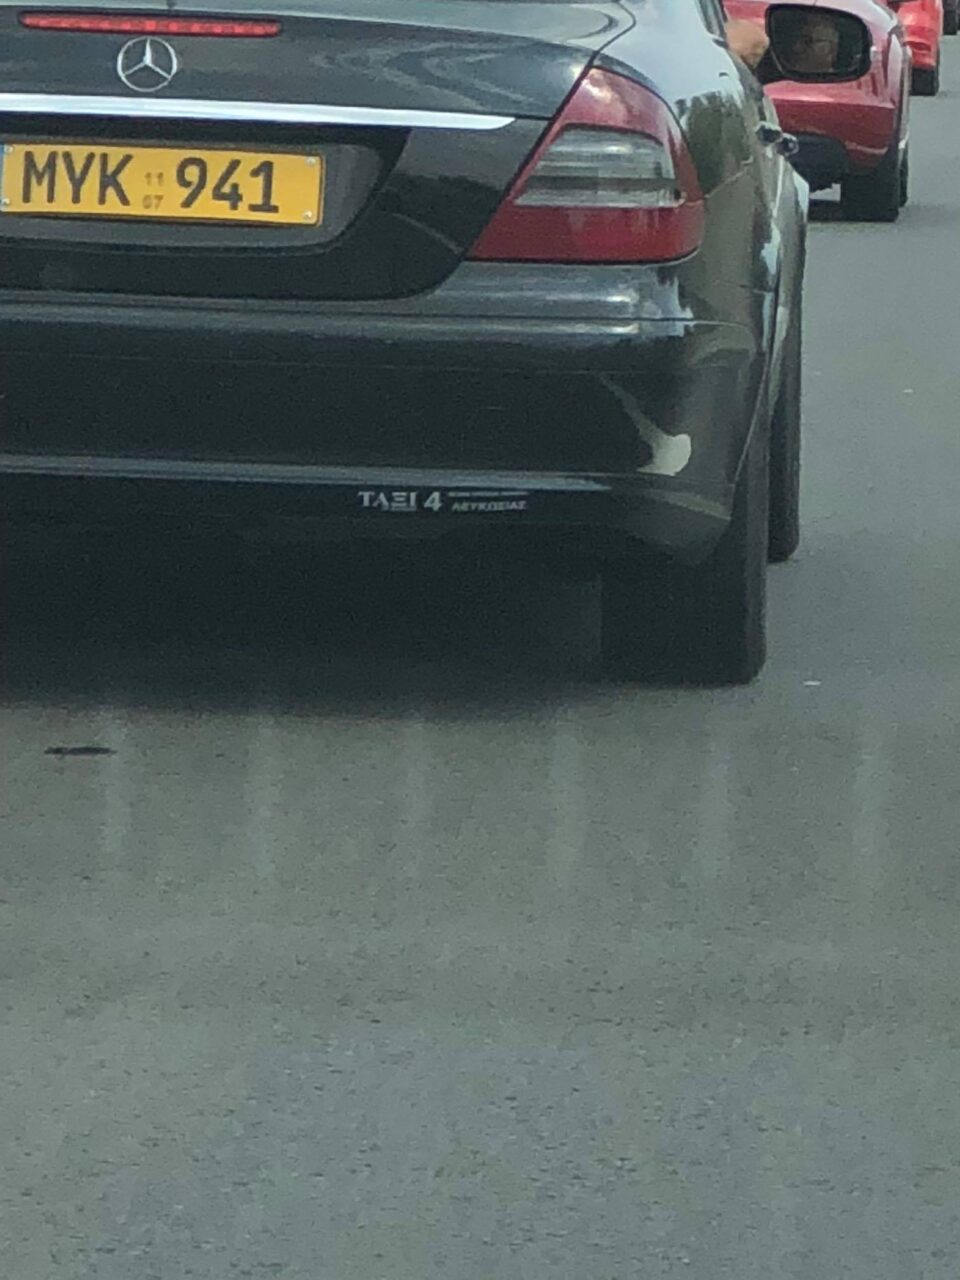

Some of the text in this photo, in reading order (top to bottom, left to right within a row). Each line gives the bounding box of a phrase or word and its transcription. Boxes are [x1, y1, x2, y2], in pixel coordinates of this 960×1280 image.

[21, 149, 279, 214] MYK 941
[423, 491, 443, 512] 4
